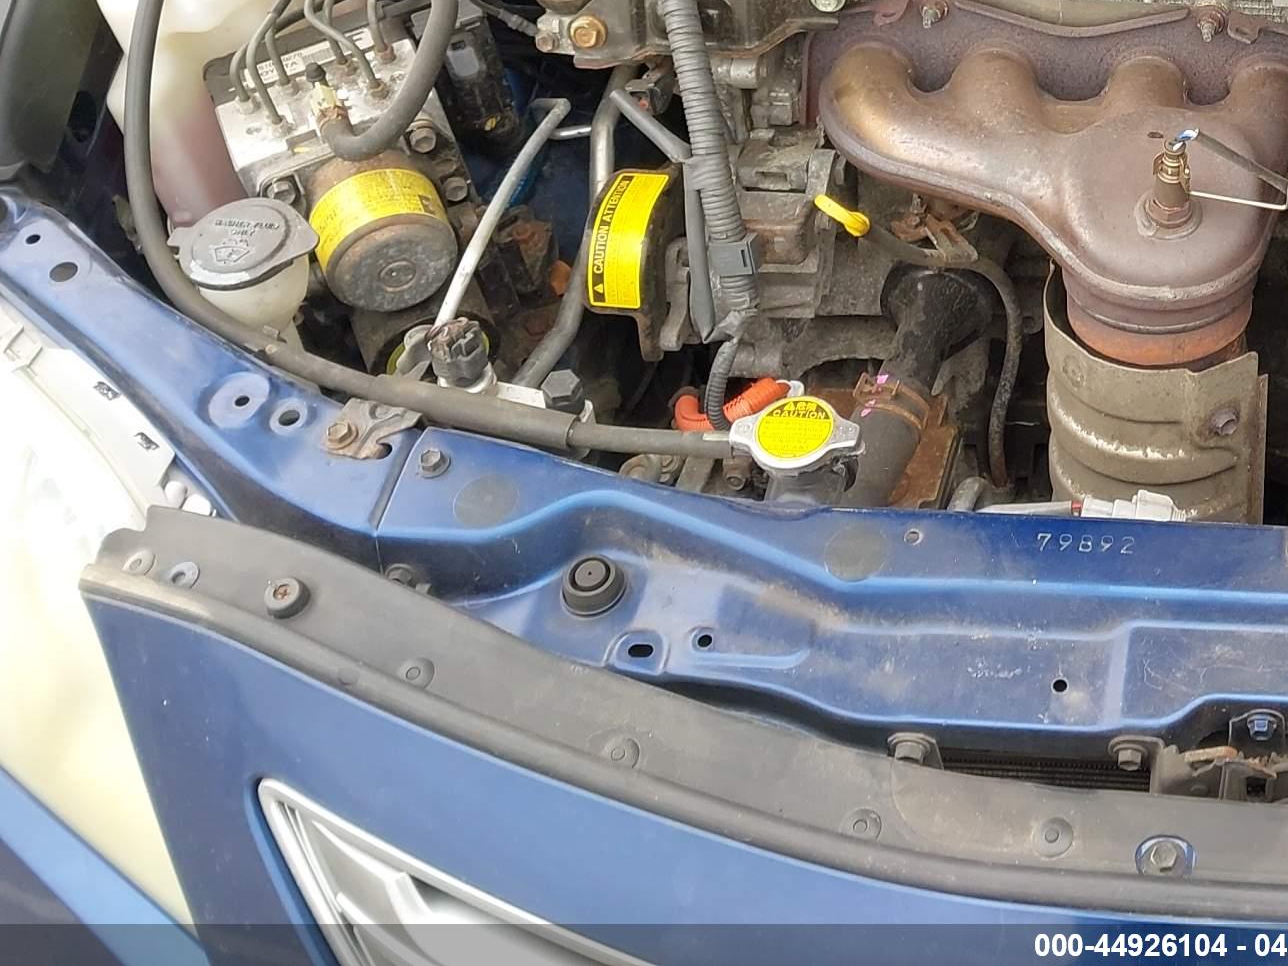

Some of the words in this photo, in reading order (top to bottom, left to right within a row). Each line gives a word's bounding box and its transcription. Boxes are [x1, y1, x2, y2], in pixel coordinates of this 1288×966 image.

[594, 225, 609, 274] CAUTION
[602, 180, 630, 222] ATTENTION
[772, 409, 826, 420] CAUTION
[1037, 532, 1135, 555] 79892
